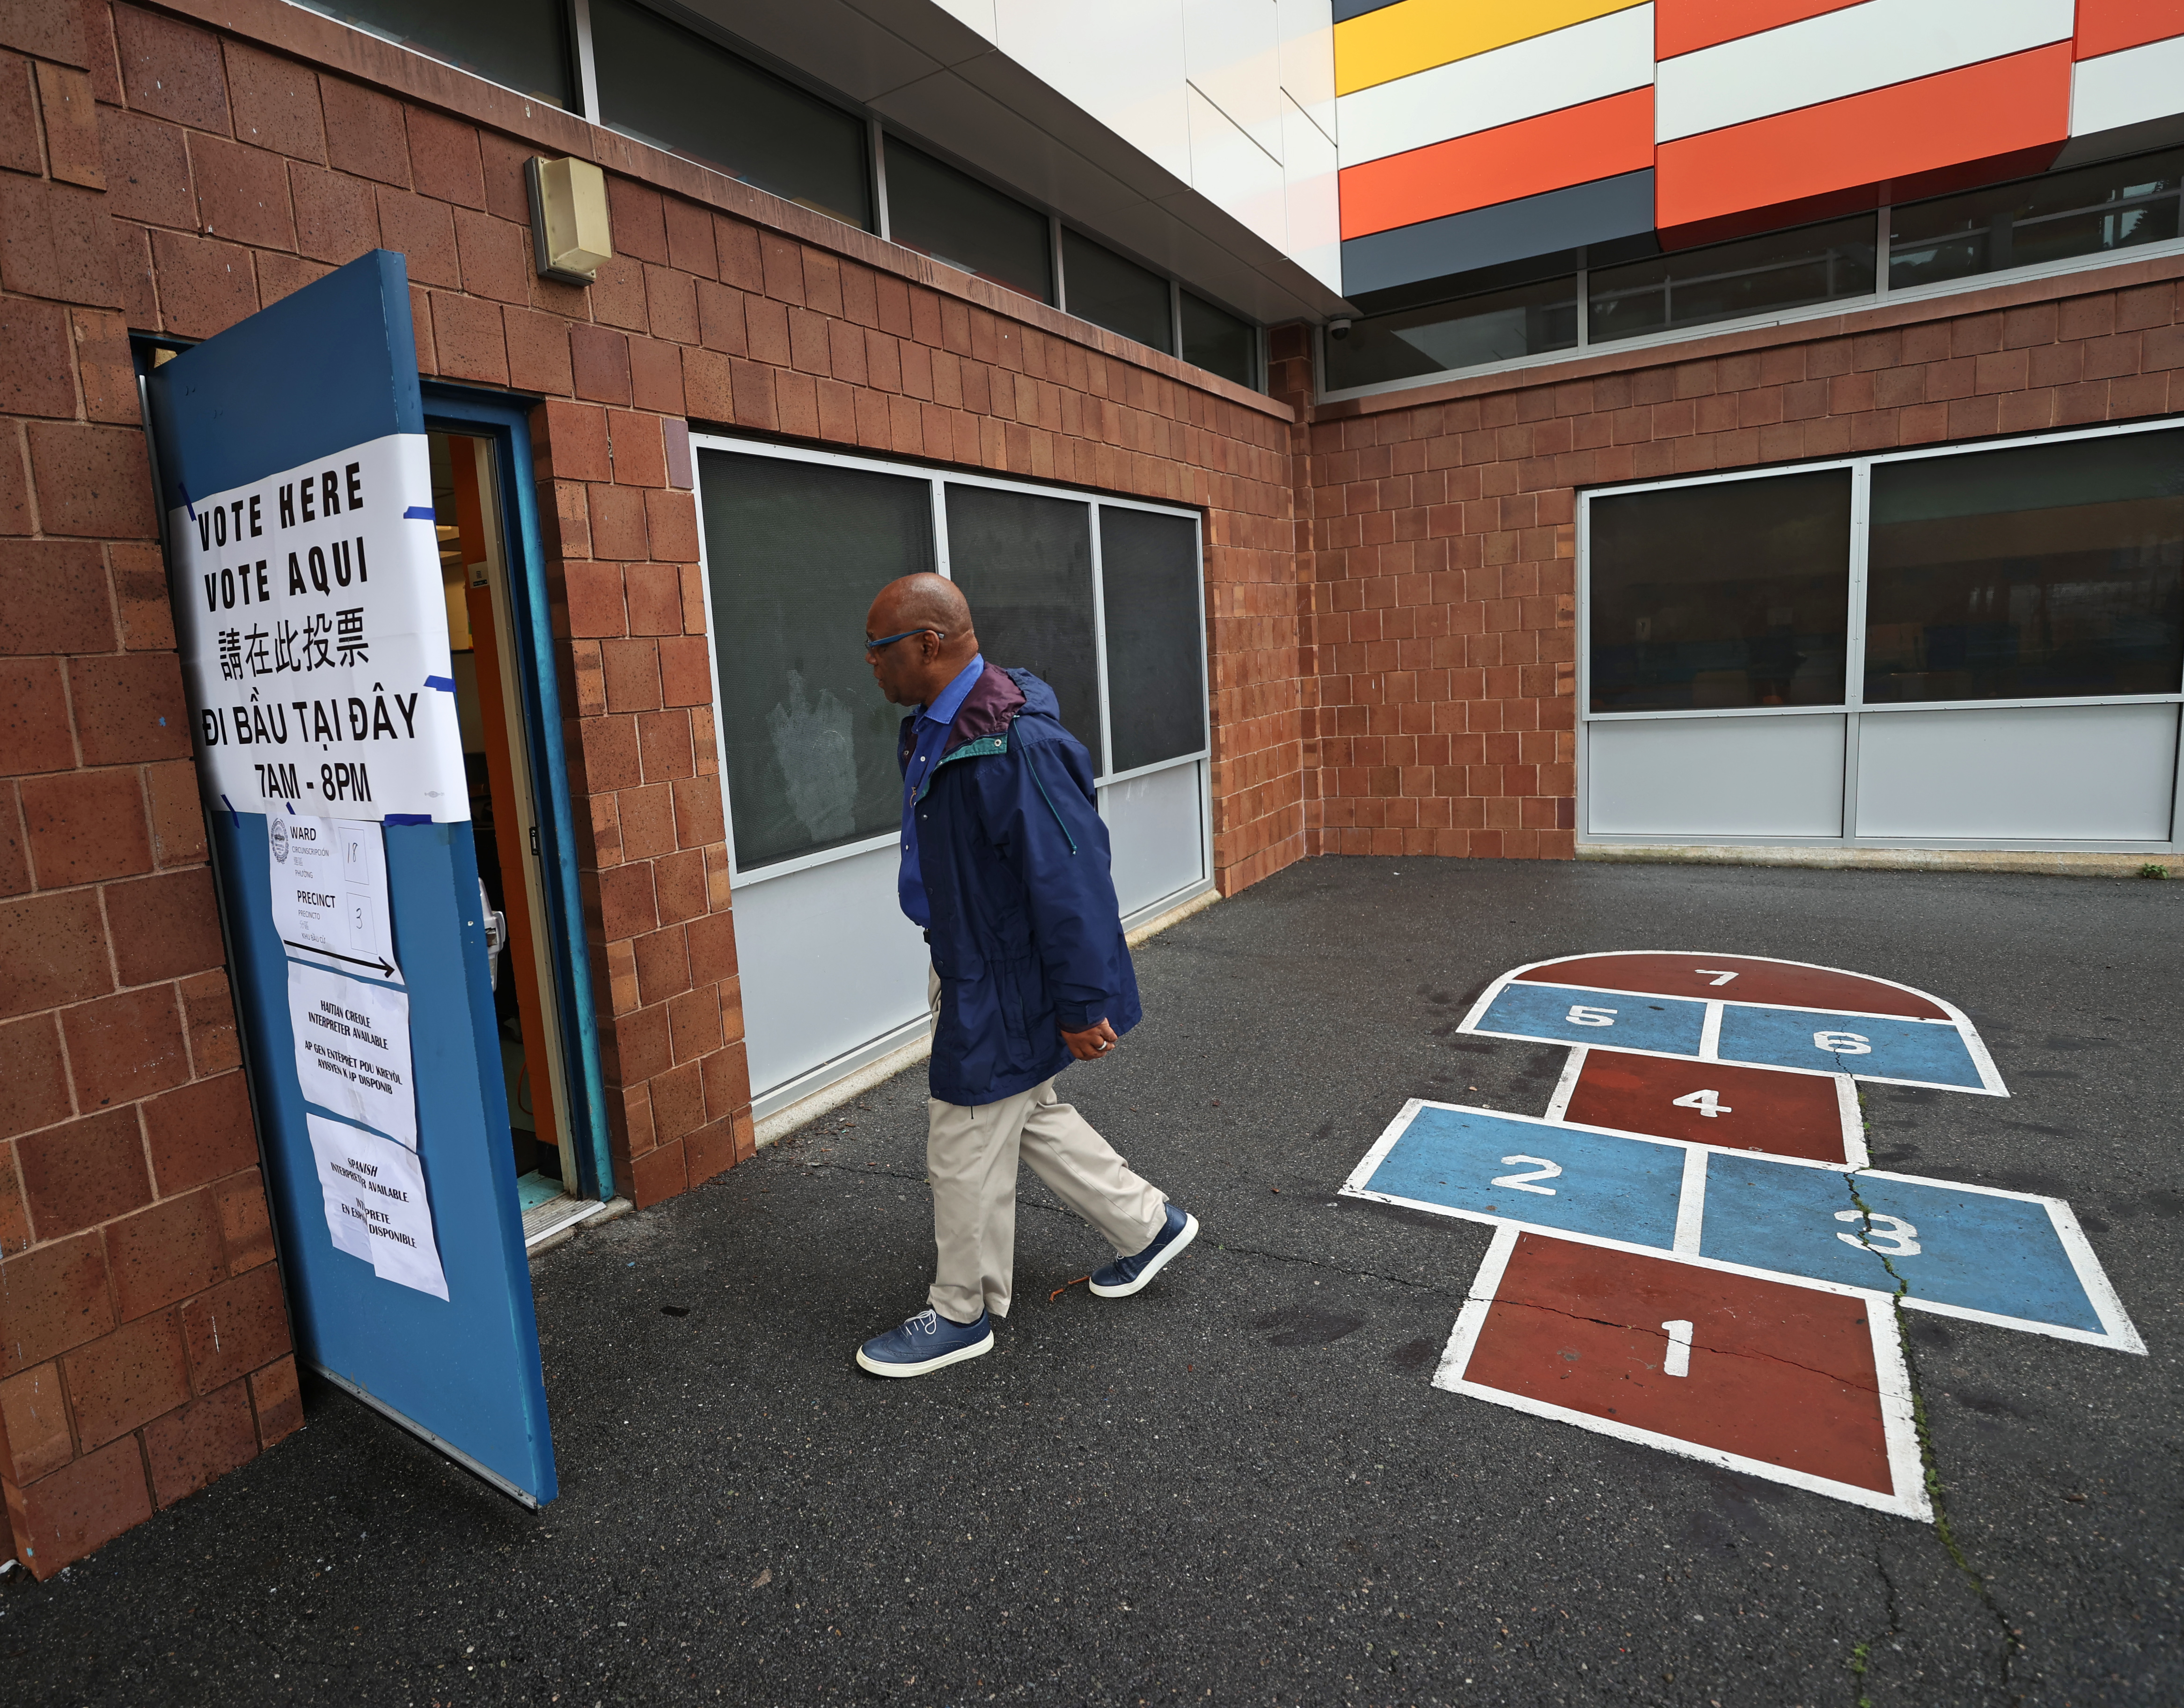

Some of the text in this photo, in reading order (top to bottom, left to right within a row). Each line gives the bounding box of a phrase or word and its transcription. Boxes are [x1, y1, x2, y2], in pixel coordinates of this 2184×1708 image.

[198, 462, 364, 552] VOTE HERE
[204, 537, 368, 612] VOTE AQUI
[218, 607, 369, 681] 請在此投票
[202, 682, 418, 751] ĐI BẦU TẠI ĐÂY
[255, 762, 301, 799] 7AM
[321, 762, 372, 802] 8PM
[290, 826, 316, 841] WARD
[292, 846, 329, 856] CIRCUNSCRIPCIÓN
[348, 842, 358, 863] 18
[297, 890, 336, 908] PRECINCT
[298, 909, 320, 920] PRECINCTO
[356, 908, 363, 929] 3
[1695, 969, 1739, 986] 7
[321, 1000, 371, 1028] HAITIAN CREOLE
[1565, 1005, 1618, 1027] 5
[308, 1011, 388, 1050] INTERPRETER AVAILABLE
[1813, 1031, 1872, 1055] 6
[305, 1040, 403, 1085] AP GEN ENTÈPRÈT POU KREYÒL
[318, 1058, 342, 1075] AYISYEN
[358, 1074, 393, 1095] DISPONIB
[1672, 1089, 1732, 1118] 4
[347, 1158, 378, 1177] SPANISH
[1491, 1155, 1562, 1196] 2
[368, 1181, 410, 1203] AVAILABLE
[341, 1203, 350, 1215] EN
[369, 1223, 417, 1249] DISPONIBLE
[1833, 1210, 1921, 1256] 3
[1662, 1319, 1693, 1377] 1
